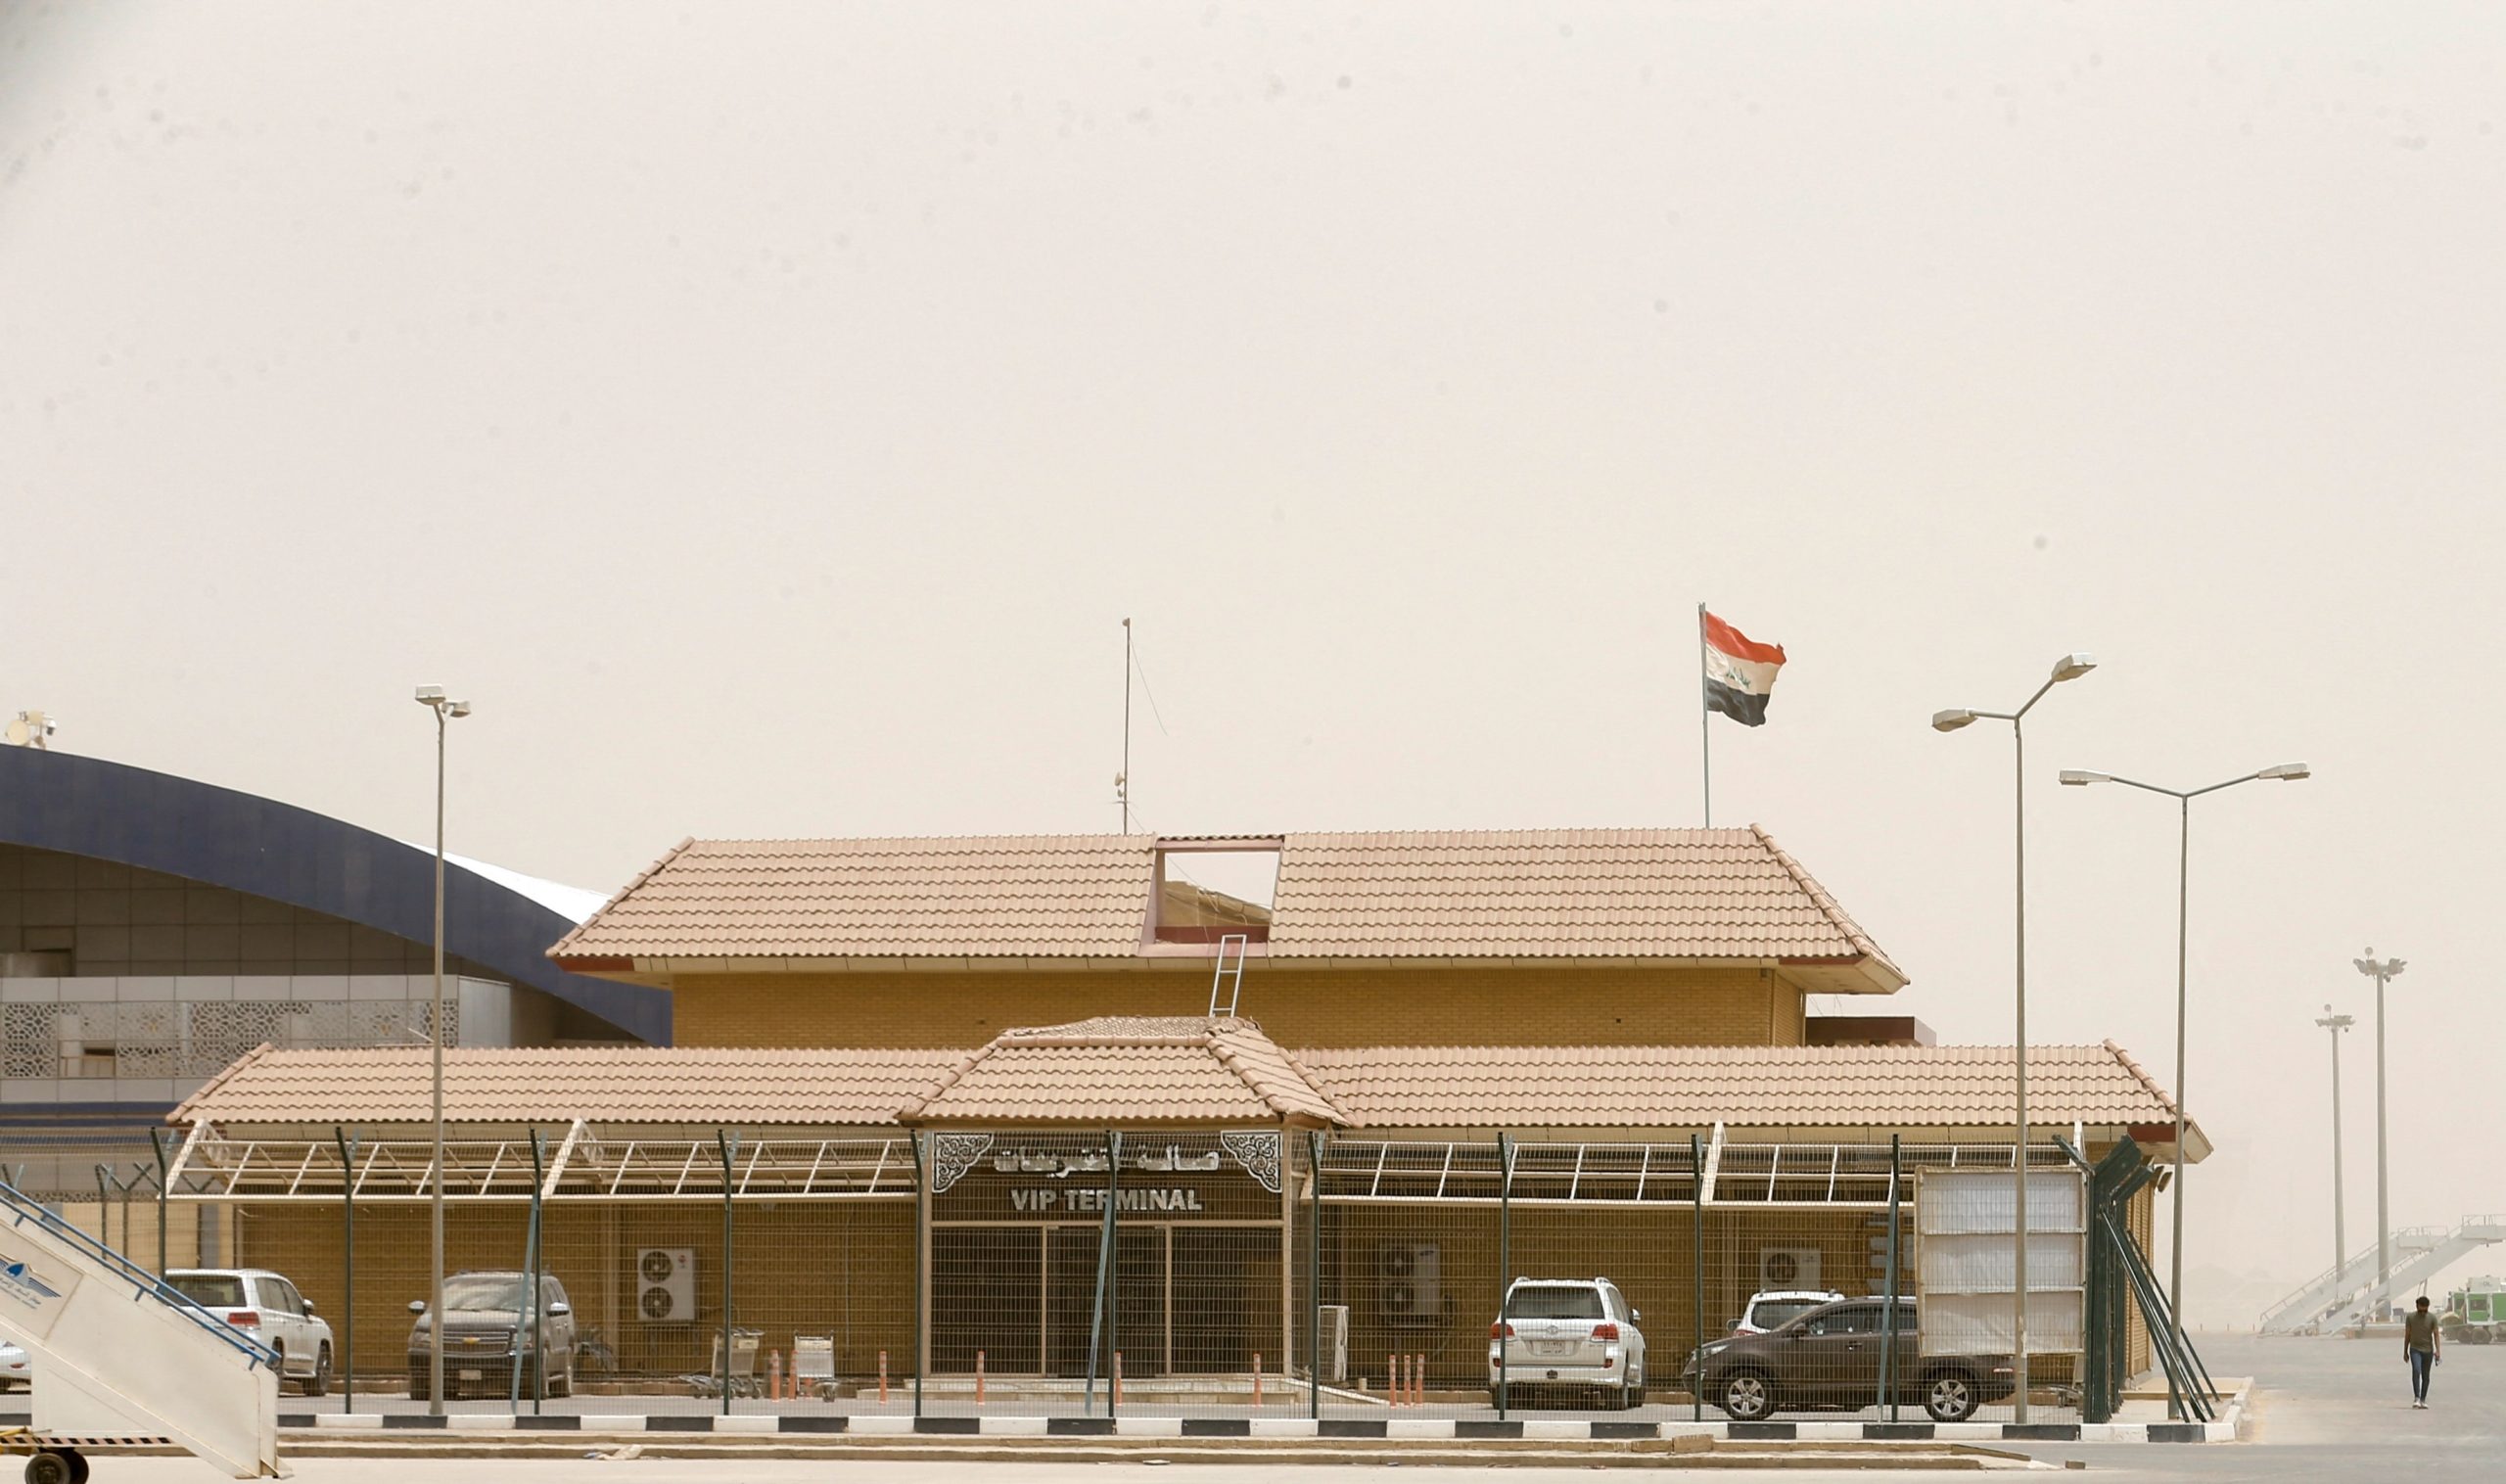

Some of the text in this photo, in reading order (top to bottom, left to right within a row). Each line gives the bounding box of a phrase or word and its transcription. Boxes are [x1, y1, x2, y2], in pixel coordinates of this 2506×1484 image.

[994, 1144, 1220, 1178] صالة تشريفات
[1011, 1189, 1202, 1210] VIP TERMINAL
